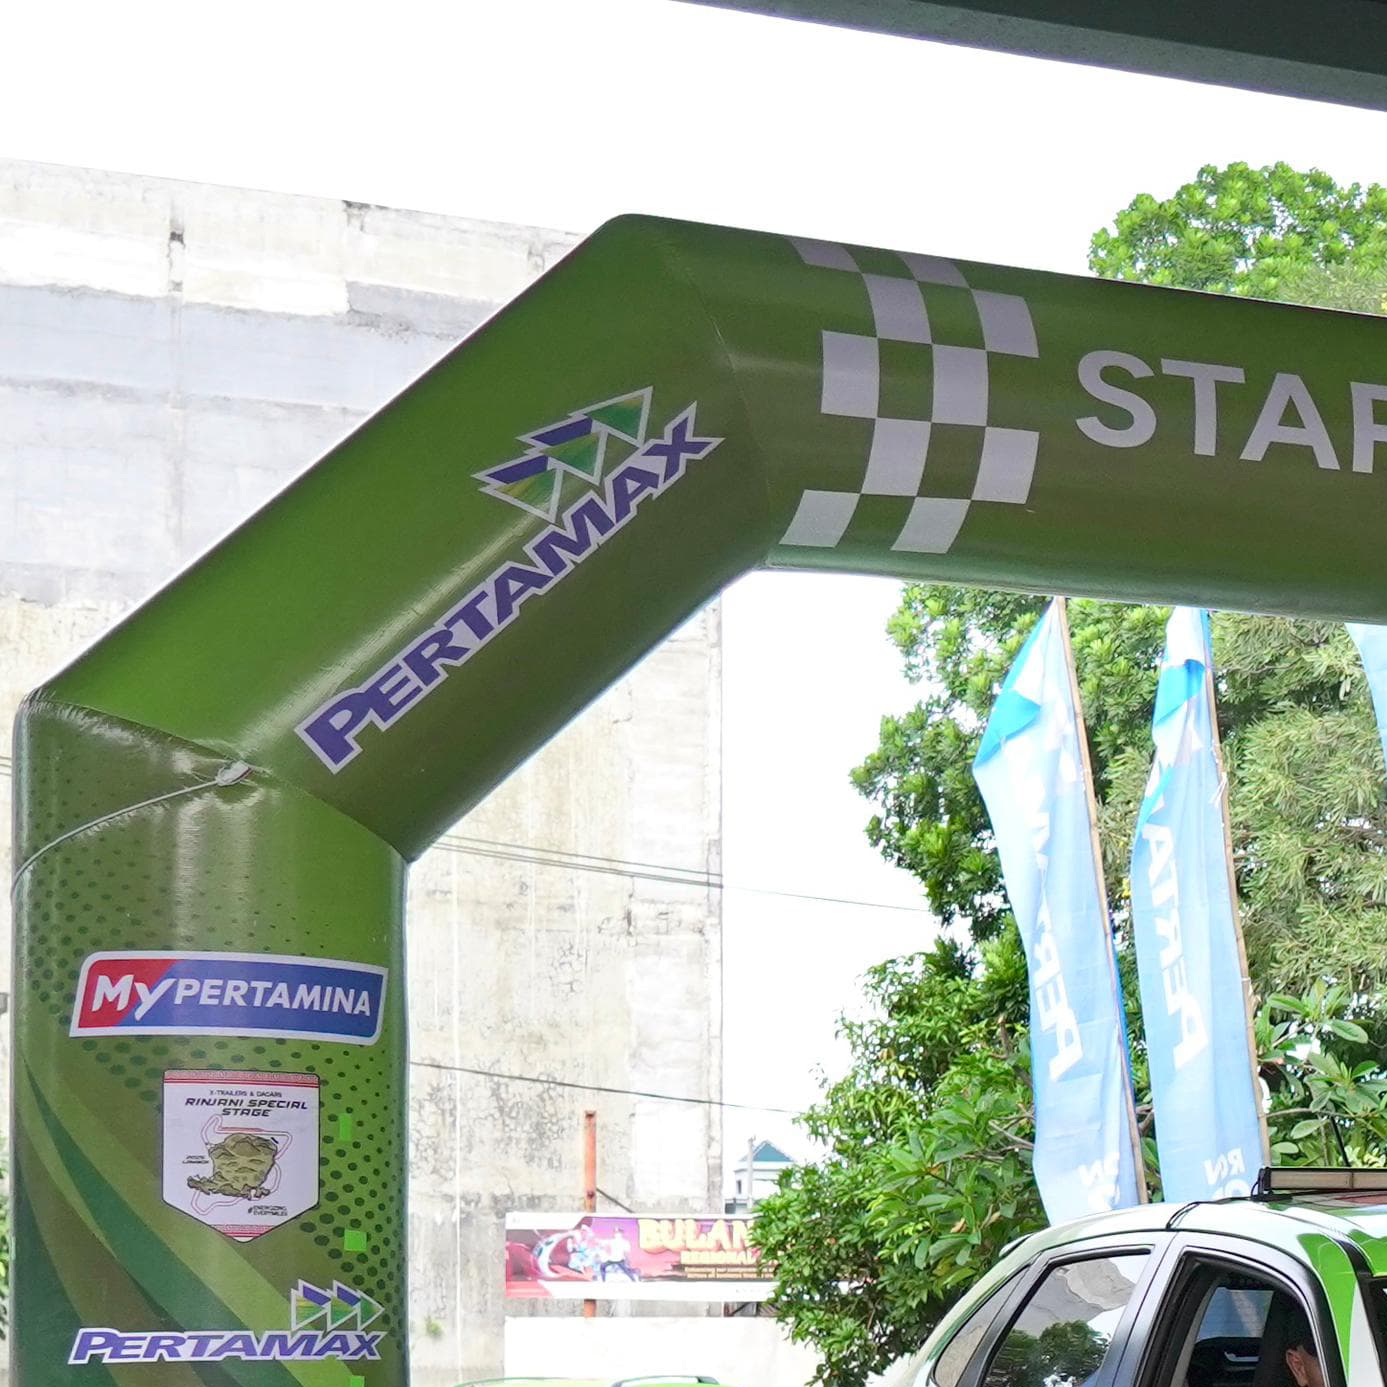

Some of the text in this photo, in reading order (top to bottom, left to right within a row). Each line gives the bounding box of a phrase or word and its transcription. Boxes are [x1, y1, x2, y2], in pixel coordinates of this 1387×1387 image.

[303, 413, 719, 767] PERTAMAX
[184, 1097, 309, 1110] RINJANI SPECIAL
[221, 1108, 272, 1117] STAGE
[72, 1330, 383, 1361] PERTAMAX
